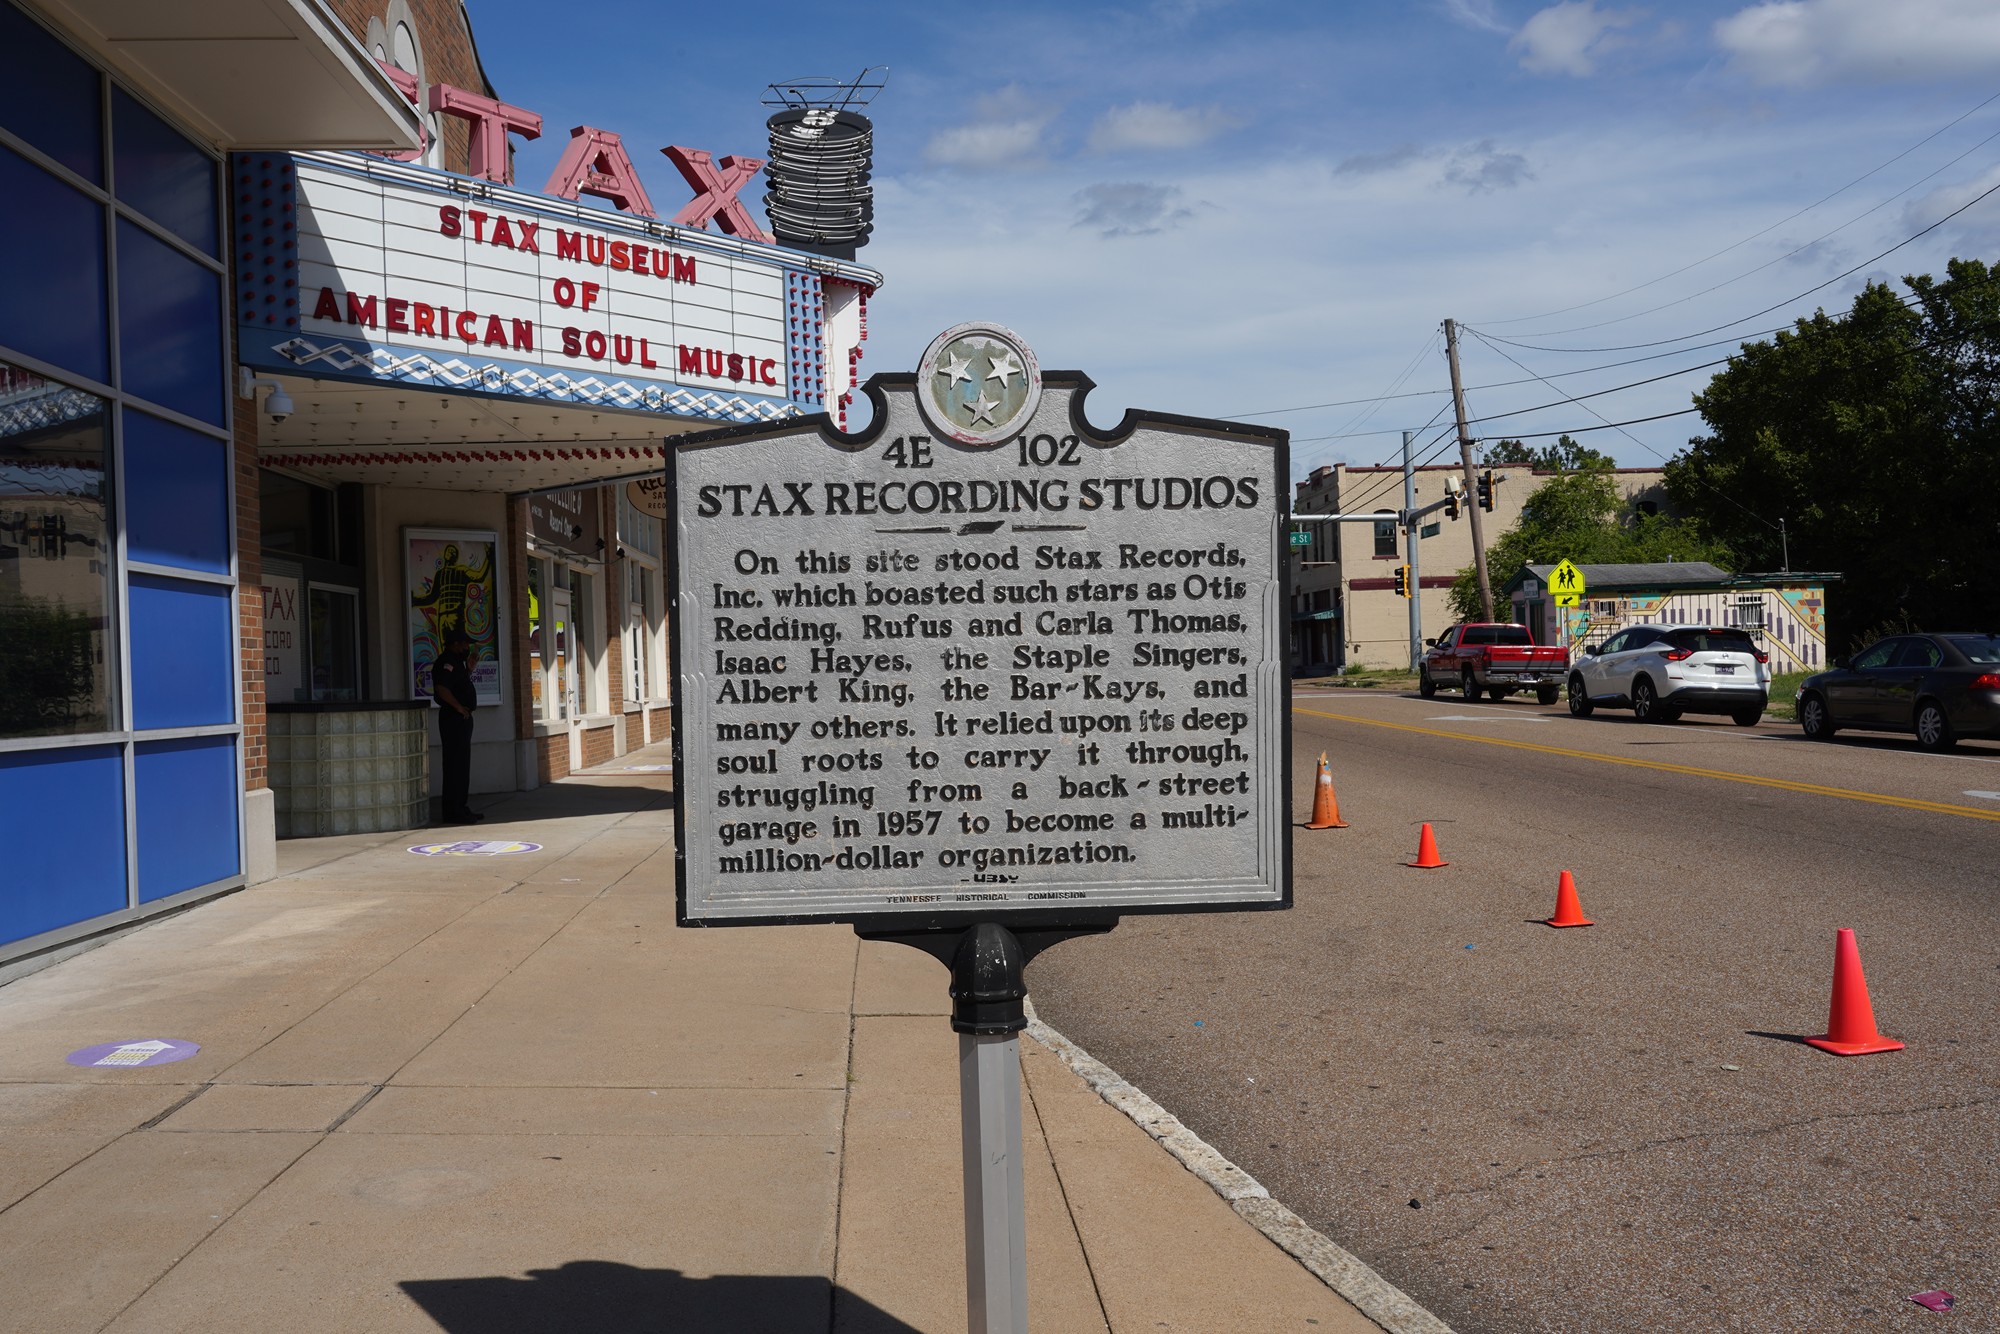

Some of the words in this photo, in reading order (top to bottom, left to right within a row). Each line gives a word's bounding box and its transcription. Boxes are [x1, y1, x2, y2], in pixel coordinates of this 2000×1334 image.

[439, 204, 541, 254] STAX
[555, 228, 697, 286] MUSEUM
[552, 276, 600, 312] OF
[312, 285, 535, 352] AMERICAN
[561, 325, 657, 369] SOUL
[678, 343, 778, 387] MUSIC
[882, 436, 933, 468] 4E
[1018, 434, 1082, 466] 102
[698, 483, 814, 517] STAX
[825, 480, 1068, 514] RECORDING
[1080, 476, 1258, 510] STUDIOS
[1298, 534, 1308, 543] St
[735, 550, 779, 574] On
[796, 550, 850, 573] this
[867, 550, 919, 572] site
[936, 546, 1019, 571] stood
[1036, 546, 1102, 569] Stax
[1119, 543, 1245, 568] Records,
[260, 586, 296, 621] TAX
[714, 584, 762, 608] Inc.
[773, 583, 856, 606] which
[866, 580, 984, 605] boasted
[994, 580, 1057, 603] such
[1067, 580, 1138, 601] stars
[1147, 583, 1176, 600] as
[1184, 575, 1246, 599] Otis
[264, 630, 292, 649] CORD
[714, 617, 841, 646] Redding,
[863, 614, 952, 638] Rufus
[969, 612, 1022, 636] and
[1036, 611, 1113, 635] Carla
[1128, 610, 1246, 633] Thomas,
[716, 650, 786, 674] Isaac
[811, 648, 911, 677] Hayes,
[941, 647, 987, 670] the
[1013, 645, 1109, 672] Staple
[1134, 643, 1246, 671] Singers,
[717, 679, 817, 703] Albert
[839, 678, 913, 707] King,
[941, 677, 988, 700] the
[1011, 675, 1165, 702] Bar-Kays,
[1195, 674, 1247, 697] and
[717, 723, 800, 744] many
[811, 716, 915, 738] others.
[935, 712, 957, 736] It
[966, 711, 1053, 735] relied
[1060, 715, 1131, 737] upon
[1140, 709, 1173, 731] its
[1182, 708, 1247, 735] deep
[718, 750, 777, 774] soul
[802, 749, 882, 772] roots
[907, 747, 939, 769] to
[965, 750, 1050, 771] carry
[1078, 743, 1099, 765] it
[1126, 739, 1248, 767] through,
[718, 781, 874, 811] struggling
[907, 780, 981, 802] from
[1012, 783, 1027, 799] a
[719, 822, 816, 846] garage
[833, 816, 860, 837] in
[878, 811, 942, 836] 1957
[959, 813, 989, 834] to
[1006, 810, 1113, 832] become
[1130, 813, 1146, 829] a
[1162, 804, 1248, 828] multi-
[719, 846, 923, 873] million-dollar
[939, 841, 1135, 871] organization.
[886, 895, 942, 904] TENNESSEE
[956, 893, 1009, 902] HISTORICAL
[1027, 891, 1086, 901] COMMISSION
